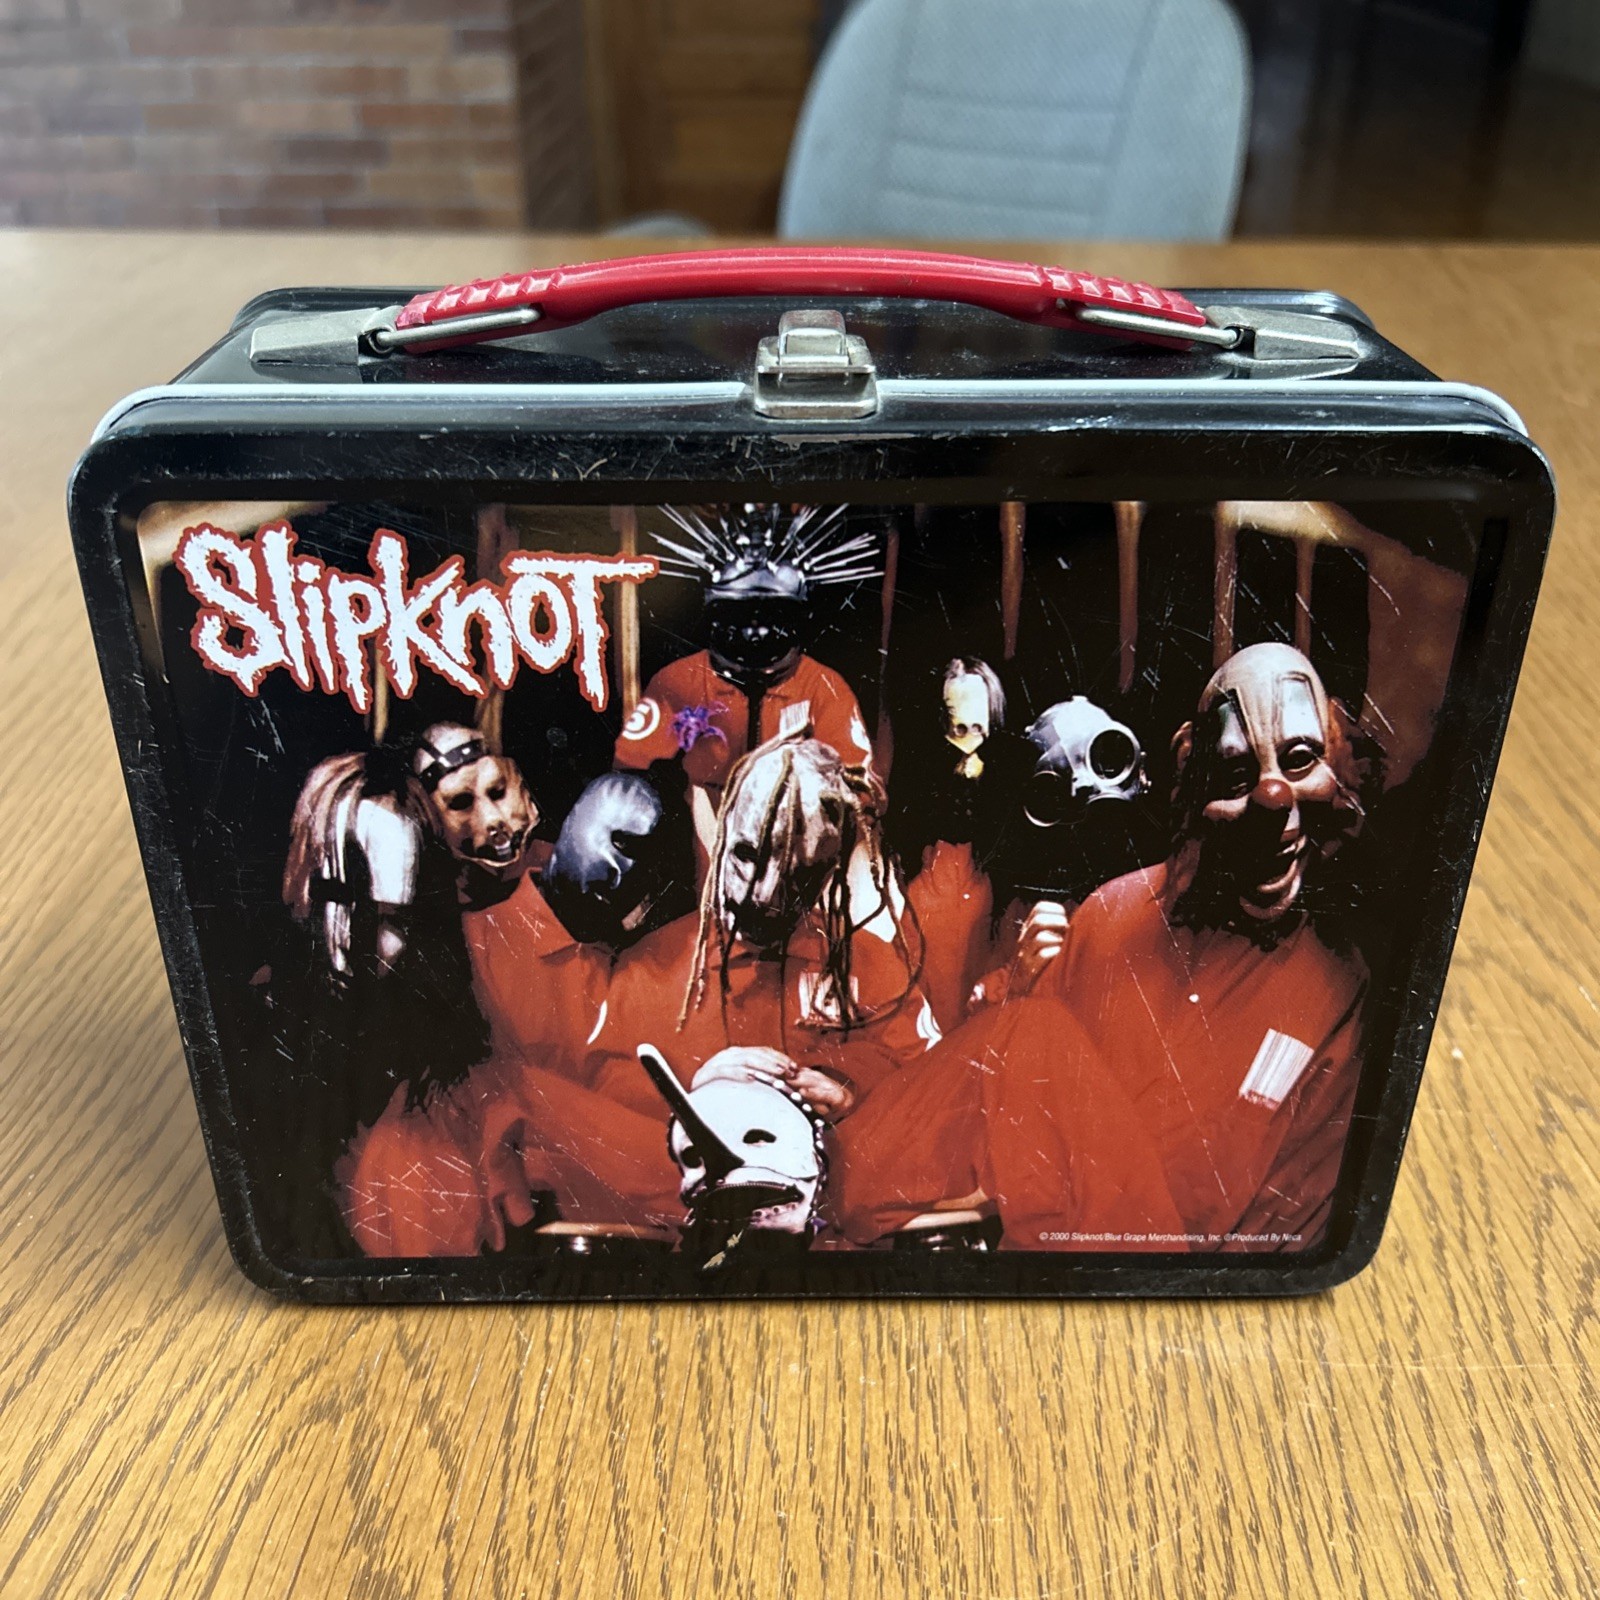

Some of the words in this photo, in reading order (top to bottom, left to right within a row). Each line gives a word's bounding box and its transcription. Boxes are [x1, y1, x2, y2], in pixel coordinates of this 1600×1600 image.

[1049, 1232, 1069, 1241] 2000
[1123, 1232, 1147, 1243] Grape
[1208, 1233, 1222, 1242] Inc.
[1270, 1233, 1280, 1243] By
